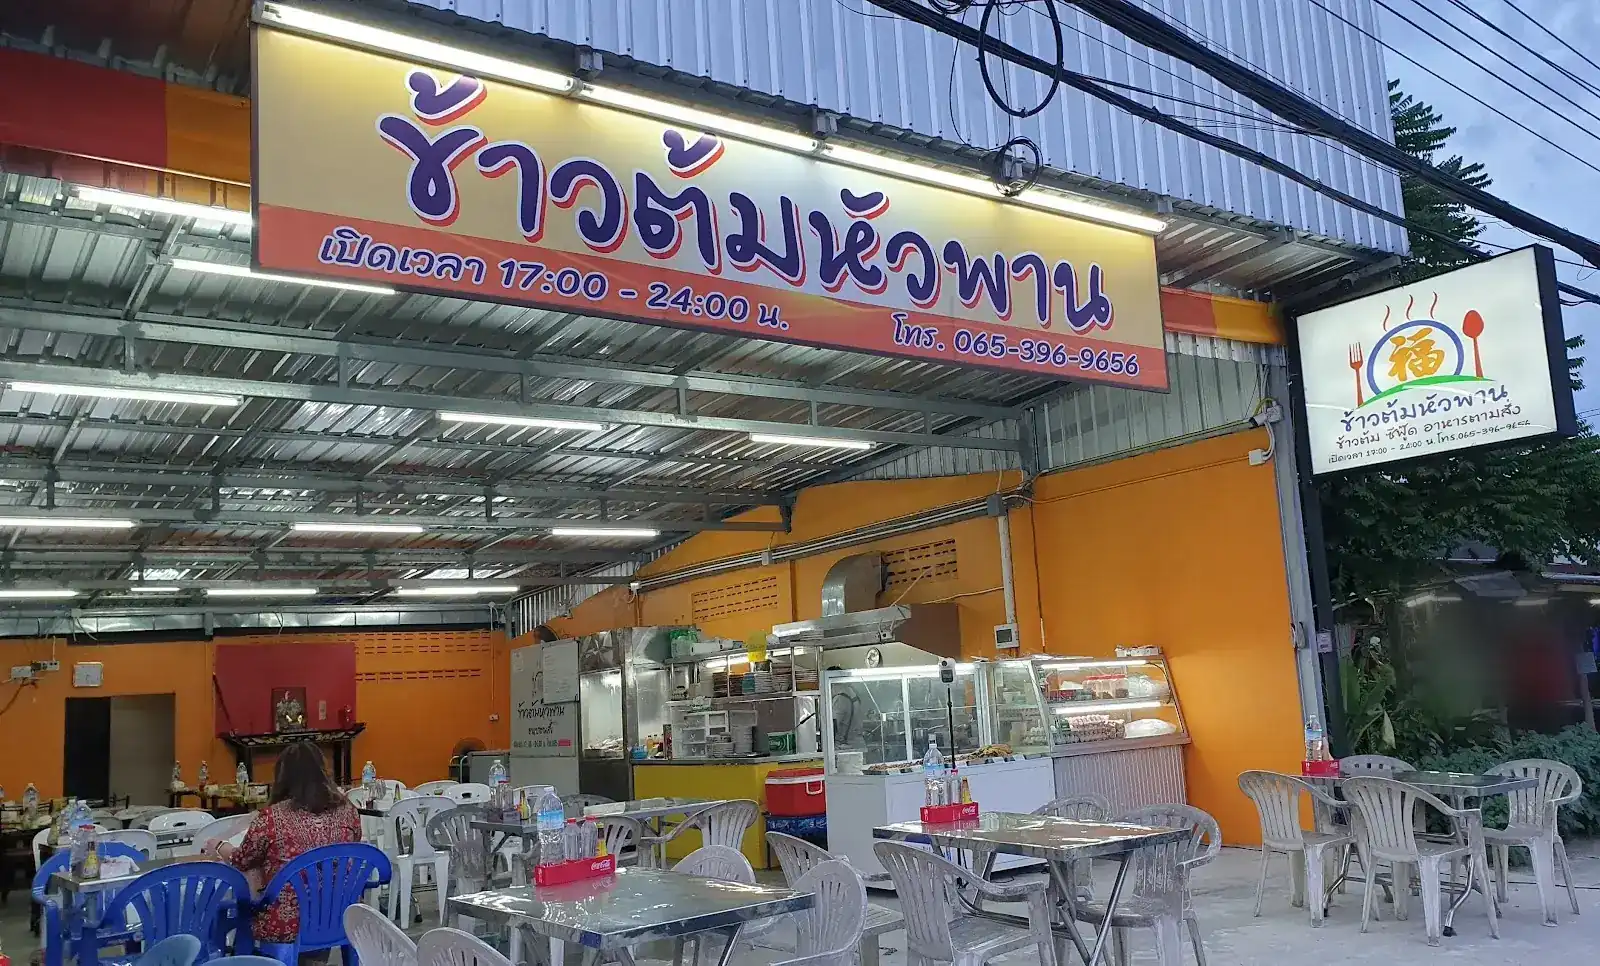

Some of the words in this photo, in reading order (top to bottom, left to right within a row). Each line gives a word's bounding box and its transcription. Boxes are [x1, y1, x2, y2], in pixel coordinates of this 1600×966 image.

[318, 226, 487, 284] เปิดเวลา
[498, 258, 609, 300] 17:00
[646, 281, 749, 323] 24:00
[757, 303, 790, 331] น.
[891, 313, 944, 351] โทร.
[954, 330, 1140, 377] 065-396-9656
[1388, 328, 1445, 381] 福
[1335, 430, 1380, 450] ข้าวต้ม
[1424, 399, 1521, 433] อาหารตามสั่ง
[1328, 451, 1363, 464] เปิดเวลา
[1366, 447, 1388, 457] 17:00
[1399, 440, 1422, 451] 24:00
